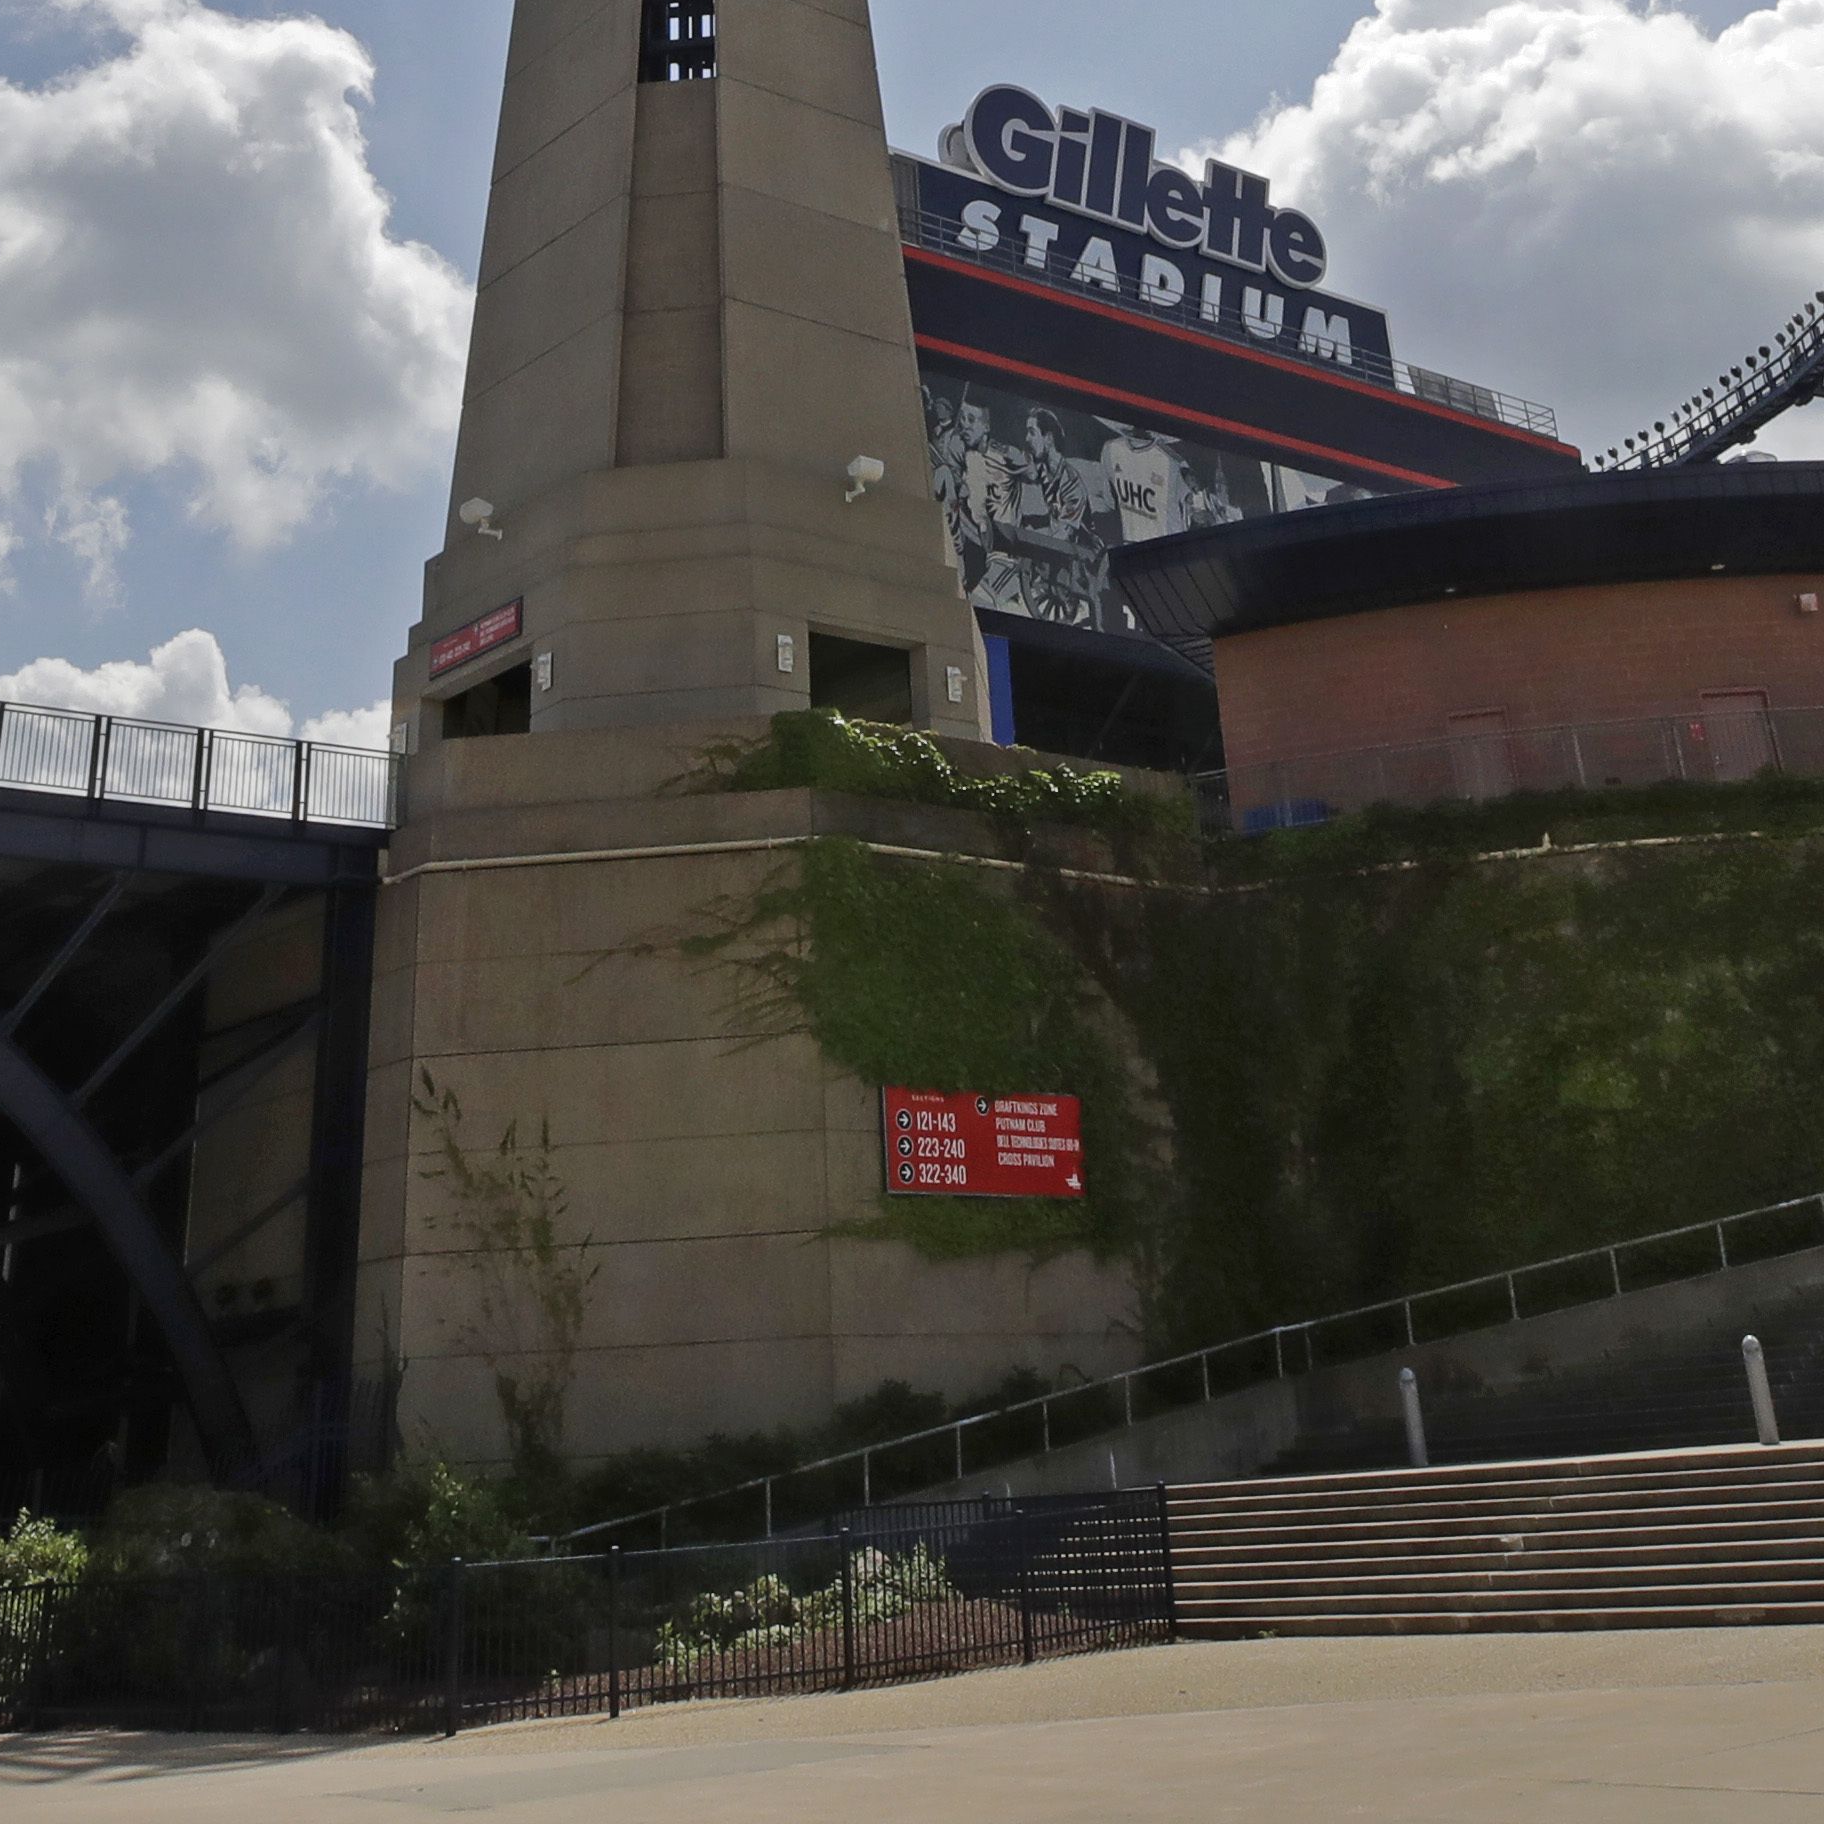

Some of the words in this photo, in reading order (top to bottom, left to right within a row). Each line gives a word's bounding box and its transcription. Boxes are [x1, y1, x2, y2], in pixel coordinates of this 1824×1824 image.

[964, 83, 1327, 289] Gillette
[956, 200, 1354, 366] STADIUM
[1117, 478, 1157, 513] UHC
[1039, 1103, 1058, 1116] ZONE
[917, 1111, 956, 1132] 121-143
[996, 1117, 1025, 1130] PUTNAM
[1027, 1119, 1046, 1132] CLUB
[918, 1137, 965, 1158] 223-240
[998, 1151, 1022, 1166] CROSS
[1023, 1153, 1055, 1167] PAVILION
[919, 1163, 967, 1184] 322-340
